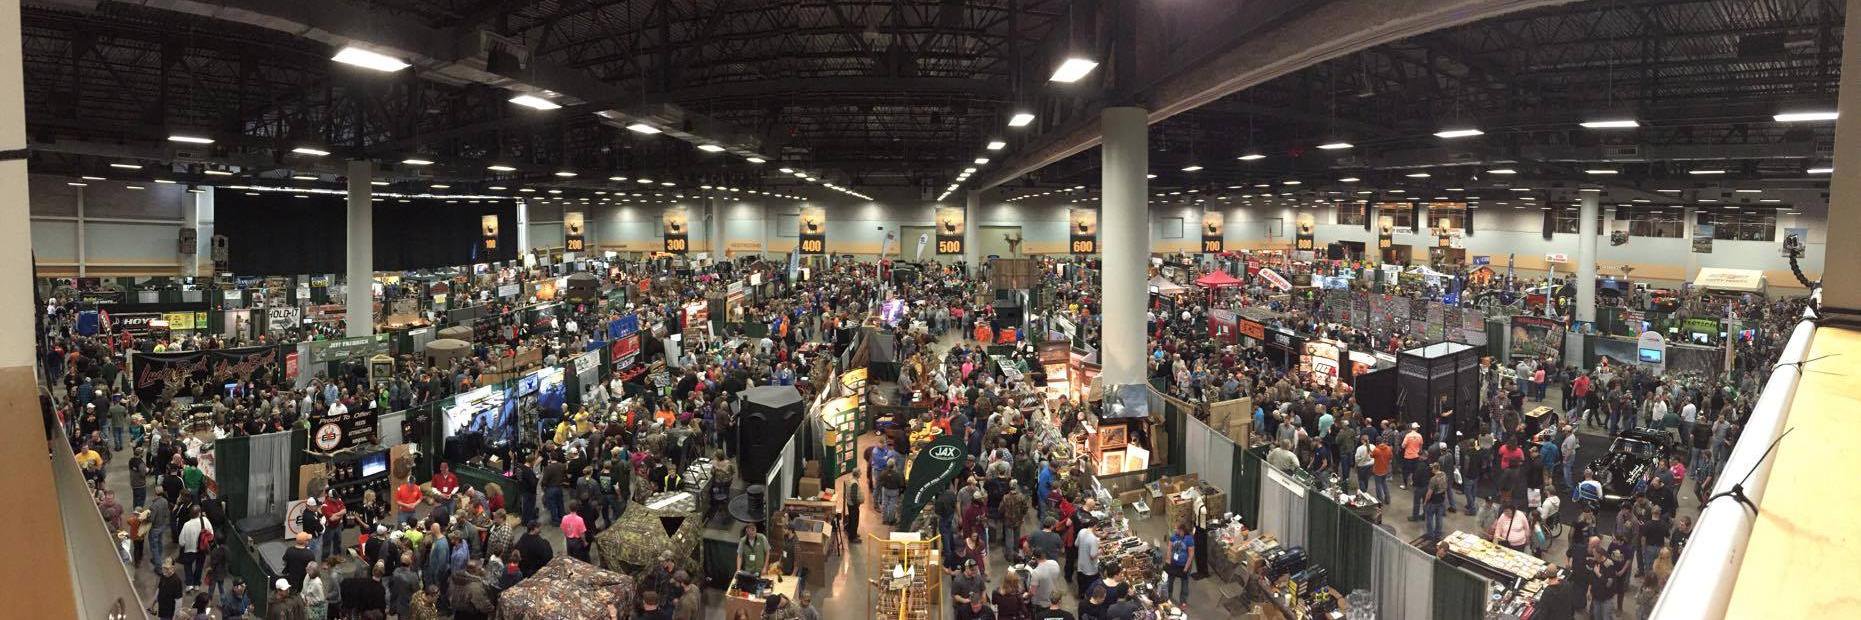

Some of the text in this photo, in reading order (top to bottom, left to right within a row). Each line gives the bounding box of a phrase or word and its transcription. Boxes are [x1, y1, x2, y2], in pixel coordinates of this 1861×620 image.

[486, 239, 496, 249] 100
[568, 240, 583, 250] 200
[667, 239, 685, 250] 300
[802, 240, 821, 252] 400
[939, 241, 960, 252] 500
[1073, 241, 1093, 252] 600
[1205, 241, 1220, 251] 700
[268, 308, 299, 319] HOLD-IT
[320, 415, 341, 424] Proud
[935, 447, 955, 457] JAX
